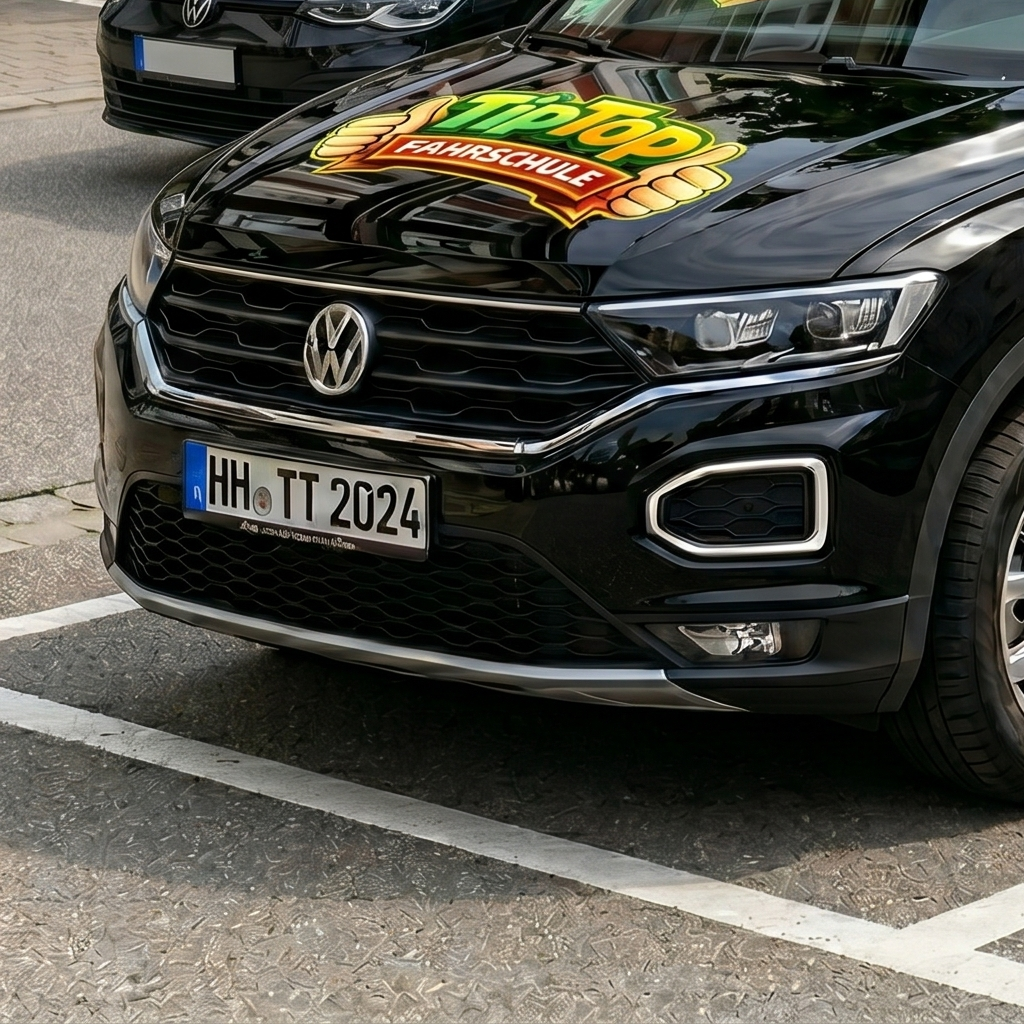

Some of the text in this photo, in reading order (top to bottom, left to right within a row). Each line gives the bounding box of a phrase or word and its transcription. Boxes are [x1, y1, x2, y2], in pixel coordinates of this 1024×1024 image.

[394, 139, 605, 187] FAHRSCHULE
[431, 93, 701, 163] TipTop
[209, 454, 250, 511] HH
[276, 467, 319, 522] TT
[330, 476, 421, 539] 2024
